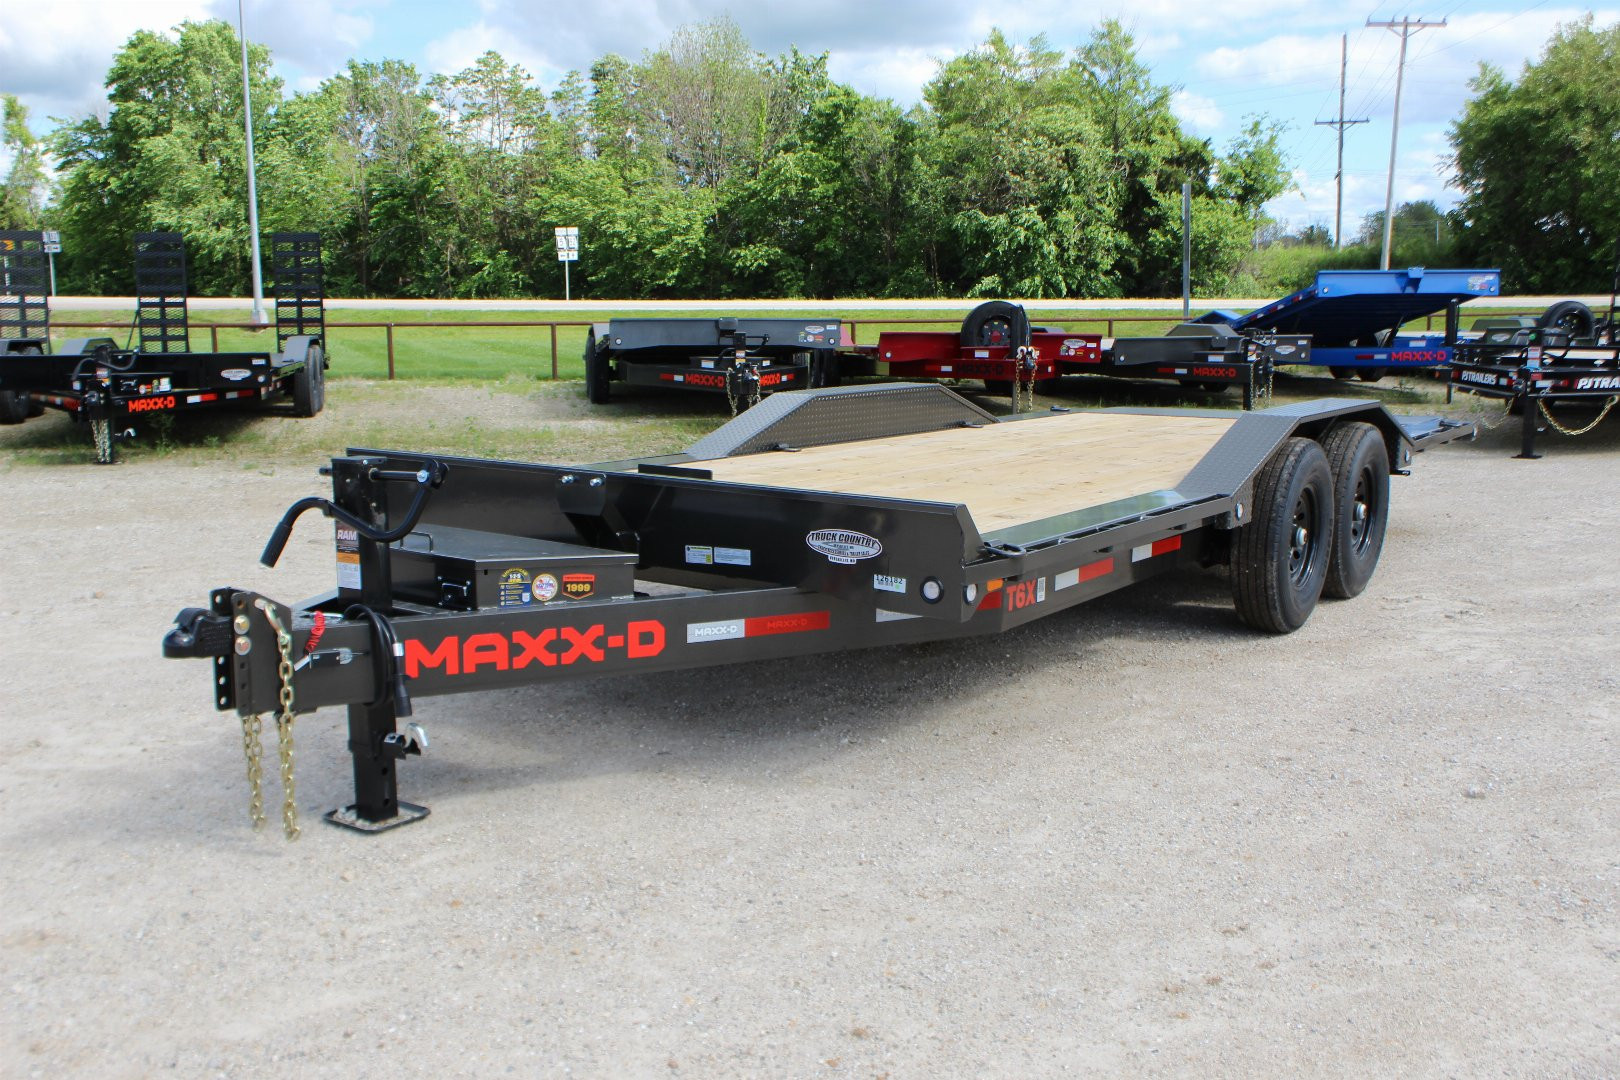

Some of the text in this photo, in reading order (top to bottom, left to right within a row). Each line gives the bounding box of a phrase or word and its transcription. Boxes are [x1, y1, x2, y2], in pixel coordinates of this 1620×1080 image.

[1391, 350, 1447, 362] MAXX-D
[1193, 366, 1237, 378] MAXX-D
[685, 373, 725, 388] MAXX-D
[128, 395, 176, 414] MAXX-D
[337, 529, 357, 541] RAM
[811, 532, 838, 541] TRUCK
[838, 533, 876, 548] COUNTRY
[566, 583, 591, 592] 1999
[1005, 579, 1037, 612] T6X
[767, 618, 808, 629] MAXX-D
[694, 625, 738, 637] MAXX-D
[403, 619, 667, 679] MAXX-D
